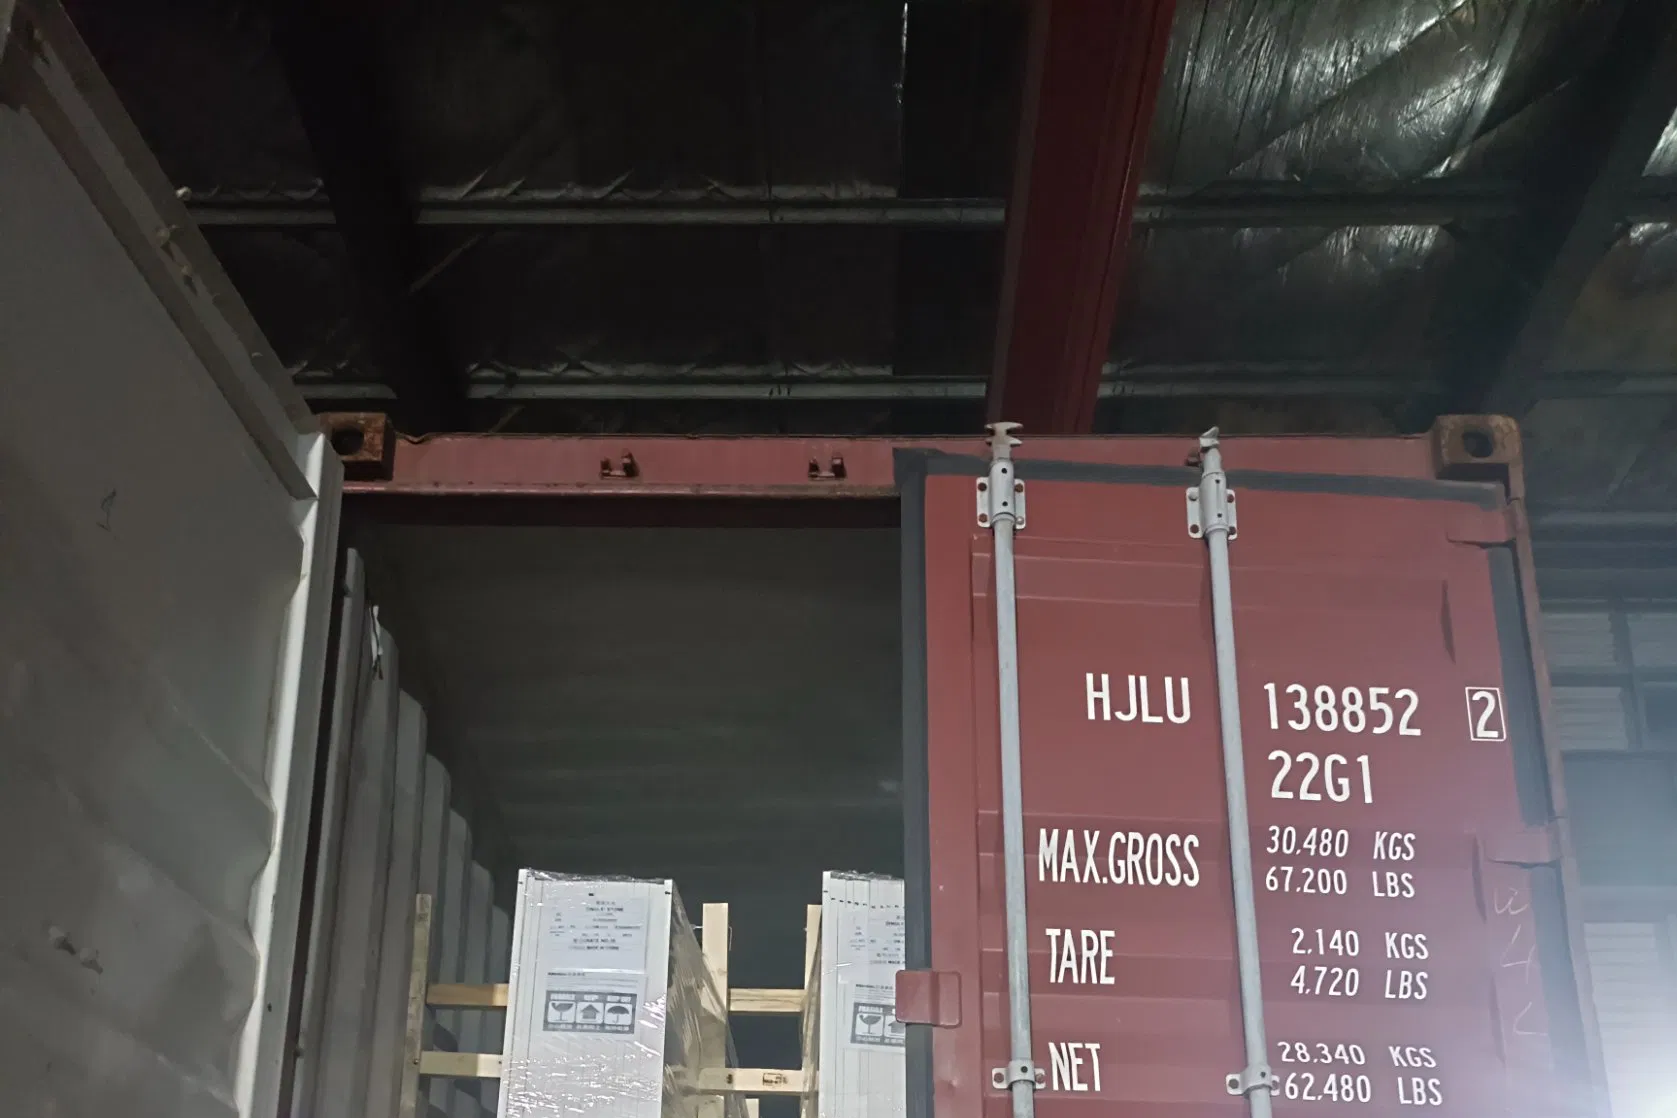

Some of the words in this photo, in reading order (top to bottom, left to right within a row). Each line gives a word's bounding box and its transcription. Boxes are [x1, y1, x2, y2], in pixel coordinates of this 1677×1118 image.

[1086, 672, 1191, 723] HJLU
[1264, 682, 1421, 736] 138852
[1472, 691, 1500, 738] 2
[1268, 750, 1372, 803] 22G1
[1038, 828, 1199, 887] MAX.GROSS
[1373, 830, 1415, 861] KGS
[1372, 871, 1415, 898] LBS
[1046, 928, 1115, 985] TARE
[1385, 932, 1429, 960] KGS
[1385, 970, 1428, 1000] LBS
[1049, 1042, 1101, 1091] NET
[1388, 1045, 1436, 1068] KGS
[1398, 1077, 1442, 1105] LBS
